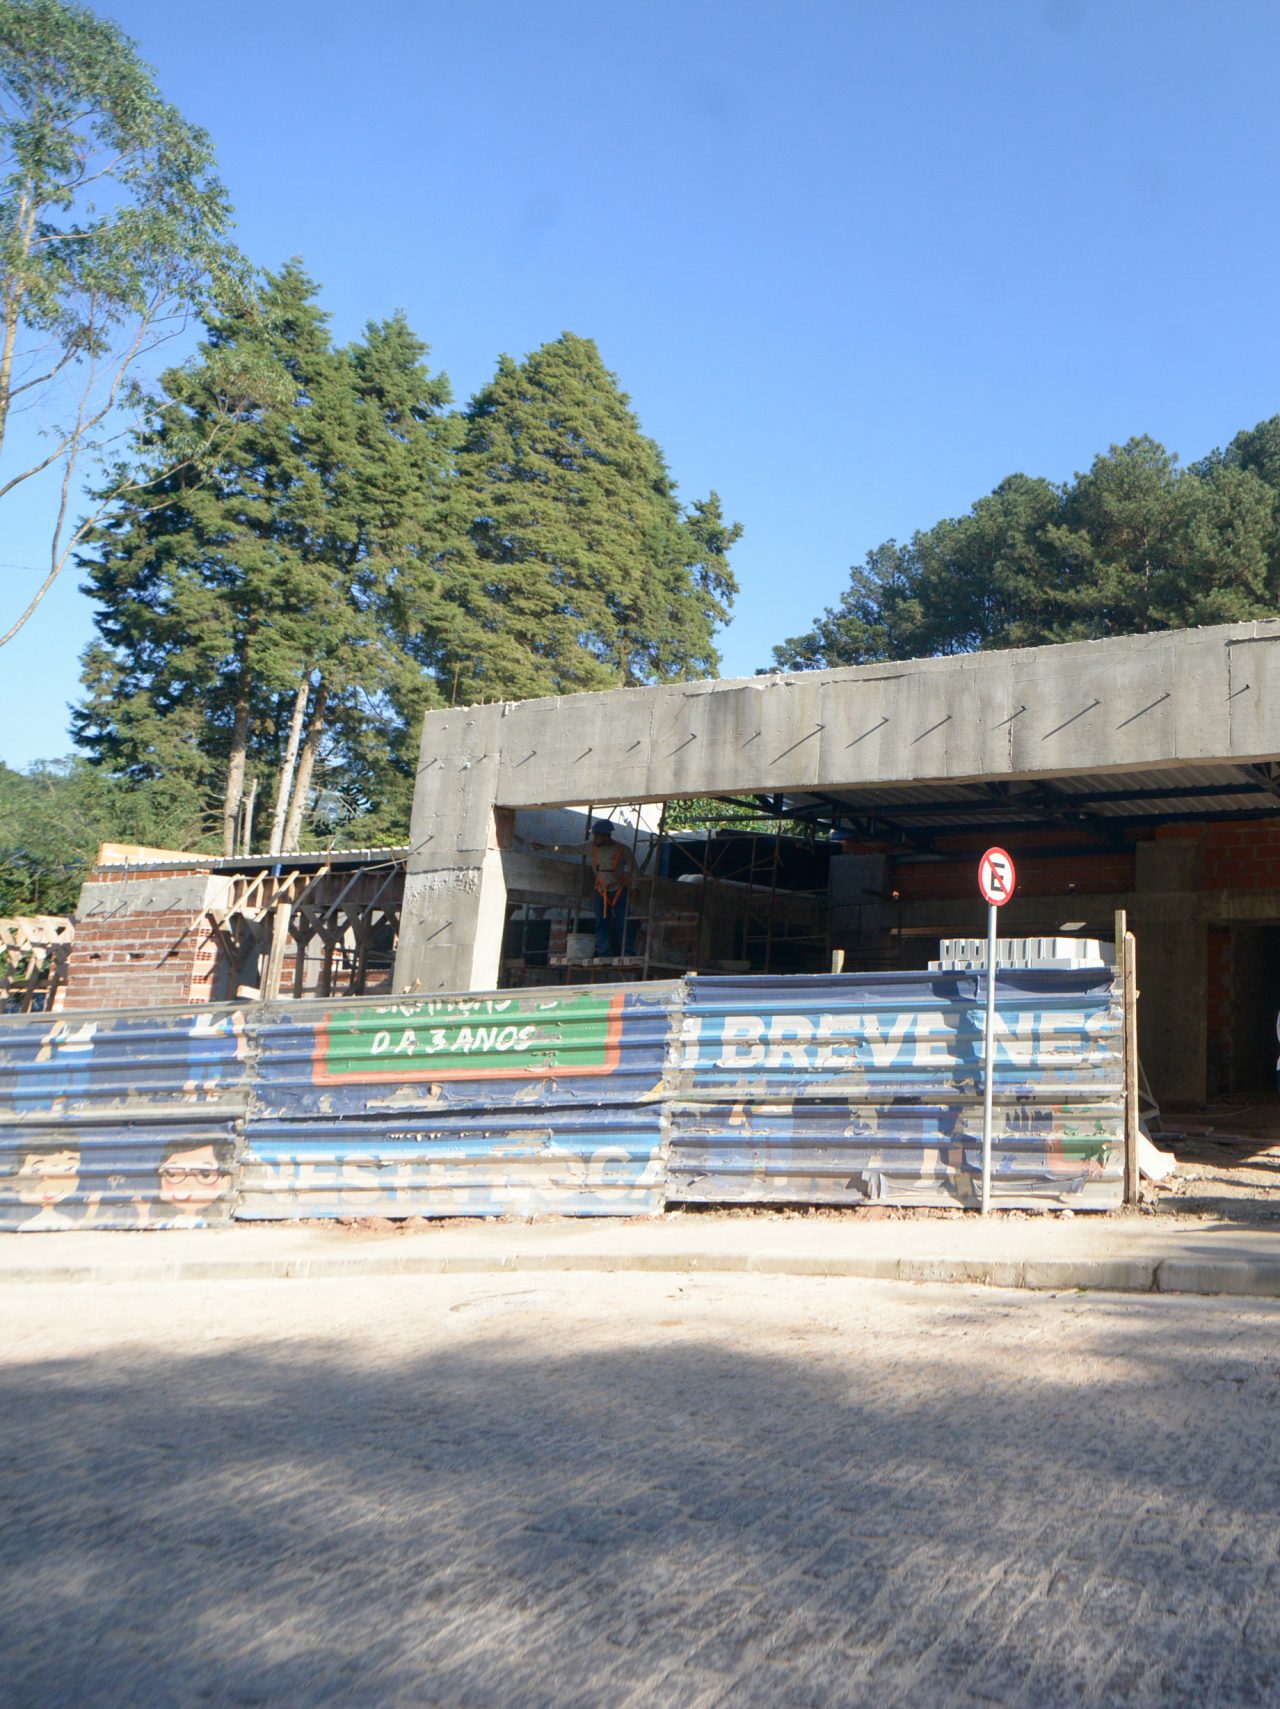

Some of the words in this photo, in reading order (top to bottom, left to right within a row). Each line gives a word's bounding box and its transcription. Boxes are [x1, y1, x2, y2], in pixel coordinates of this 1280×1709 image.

[990, 862, 1005, 892] E
[393, 1027, 417, 1056] A
[425, 1027, 448, 1054] 3
[449, 1024, 537, 1055] ANOS
[715, 1012, 964, 1069] BREVE
